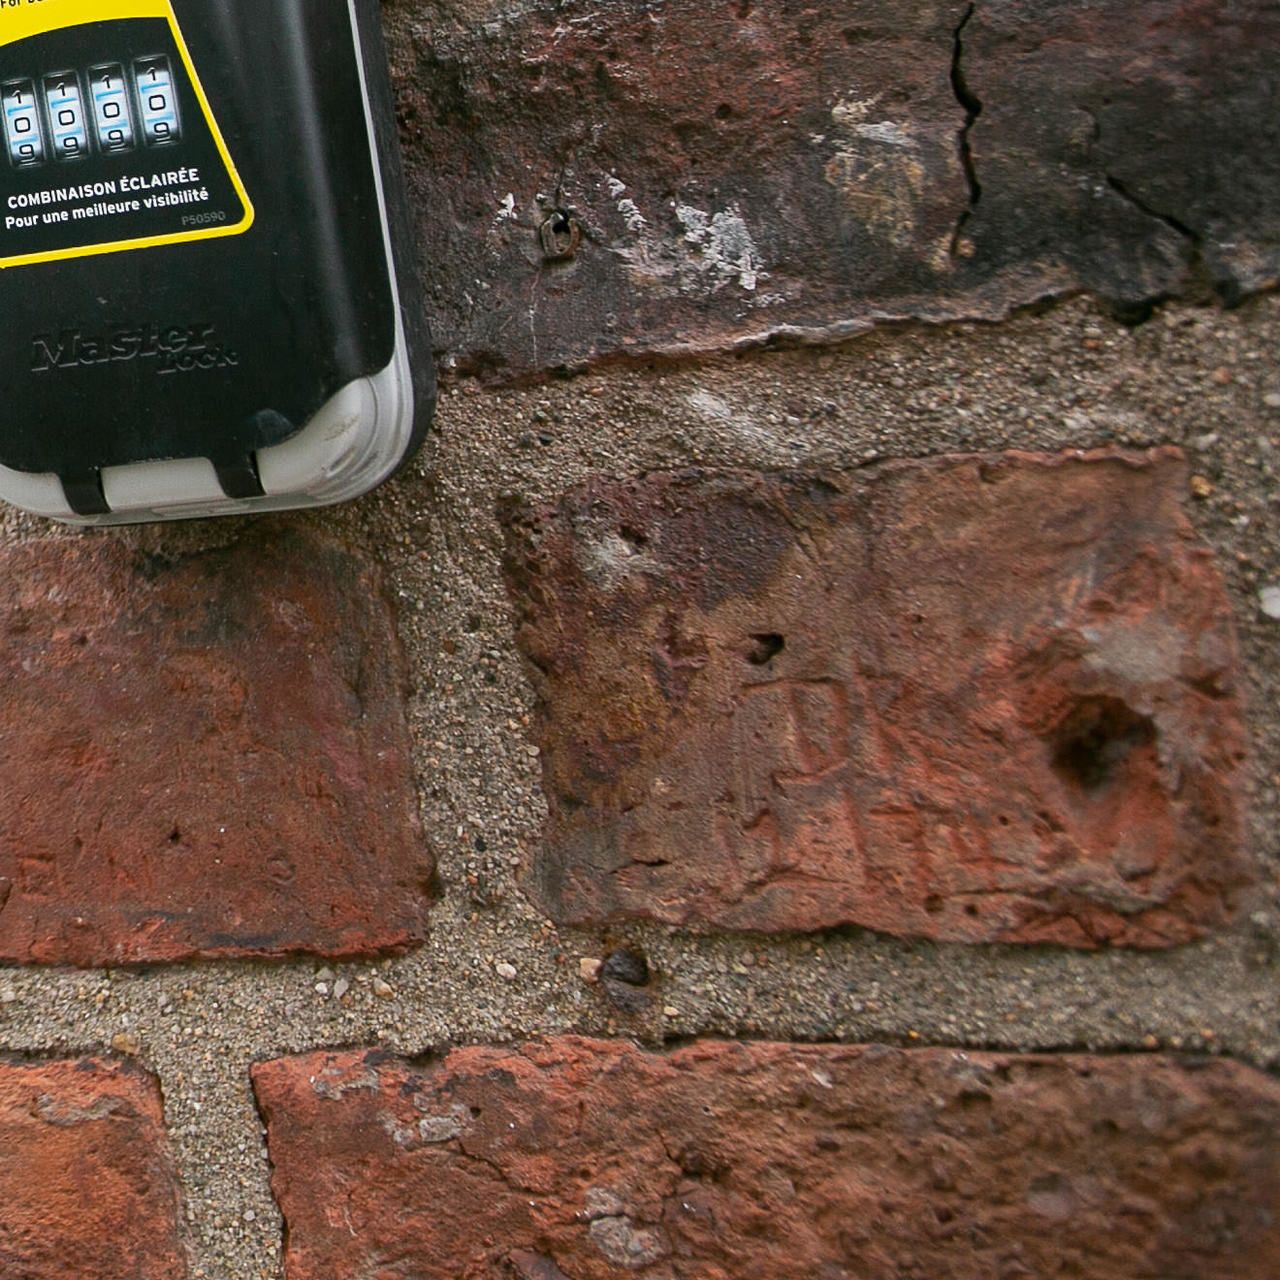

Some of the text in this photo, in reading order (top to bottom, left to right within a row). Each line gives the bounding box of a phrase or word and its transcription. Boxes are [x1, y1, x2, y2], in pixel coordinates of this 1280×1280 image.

[14, 94, 166, 133] 0 0 0 0
[5, 187, 209, 230] Pour une meilleure visibilité
[7, 167, 200, 209] COMBINAISON ÉCLAIRÉE
[181, 210, 226, 226] P50590
[31, 323, 215, 372] Master
